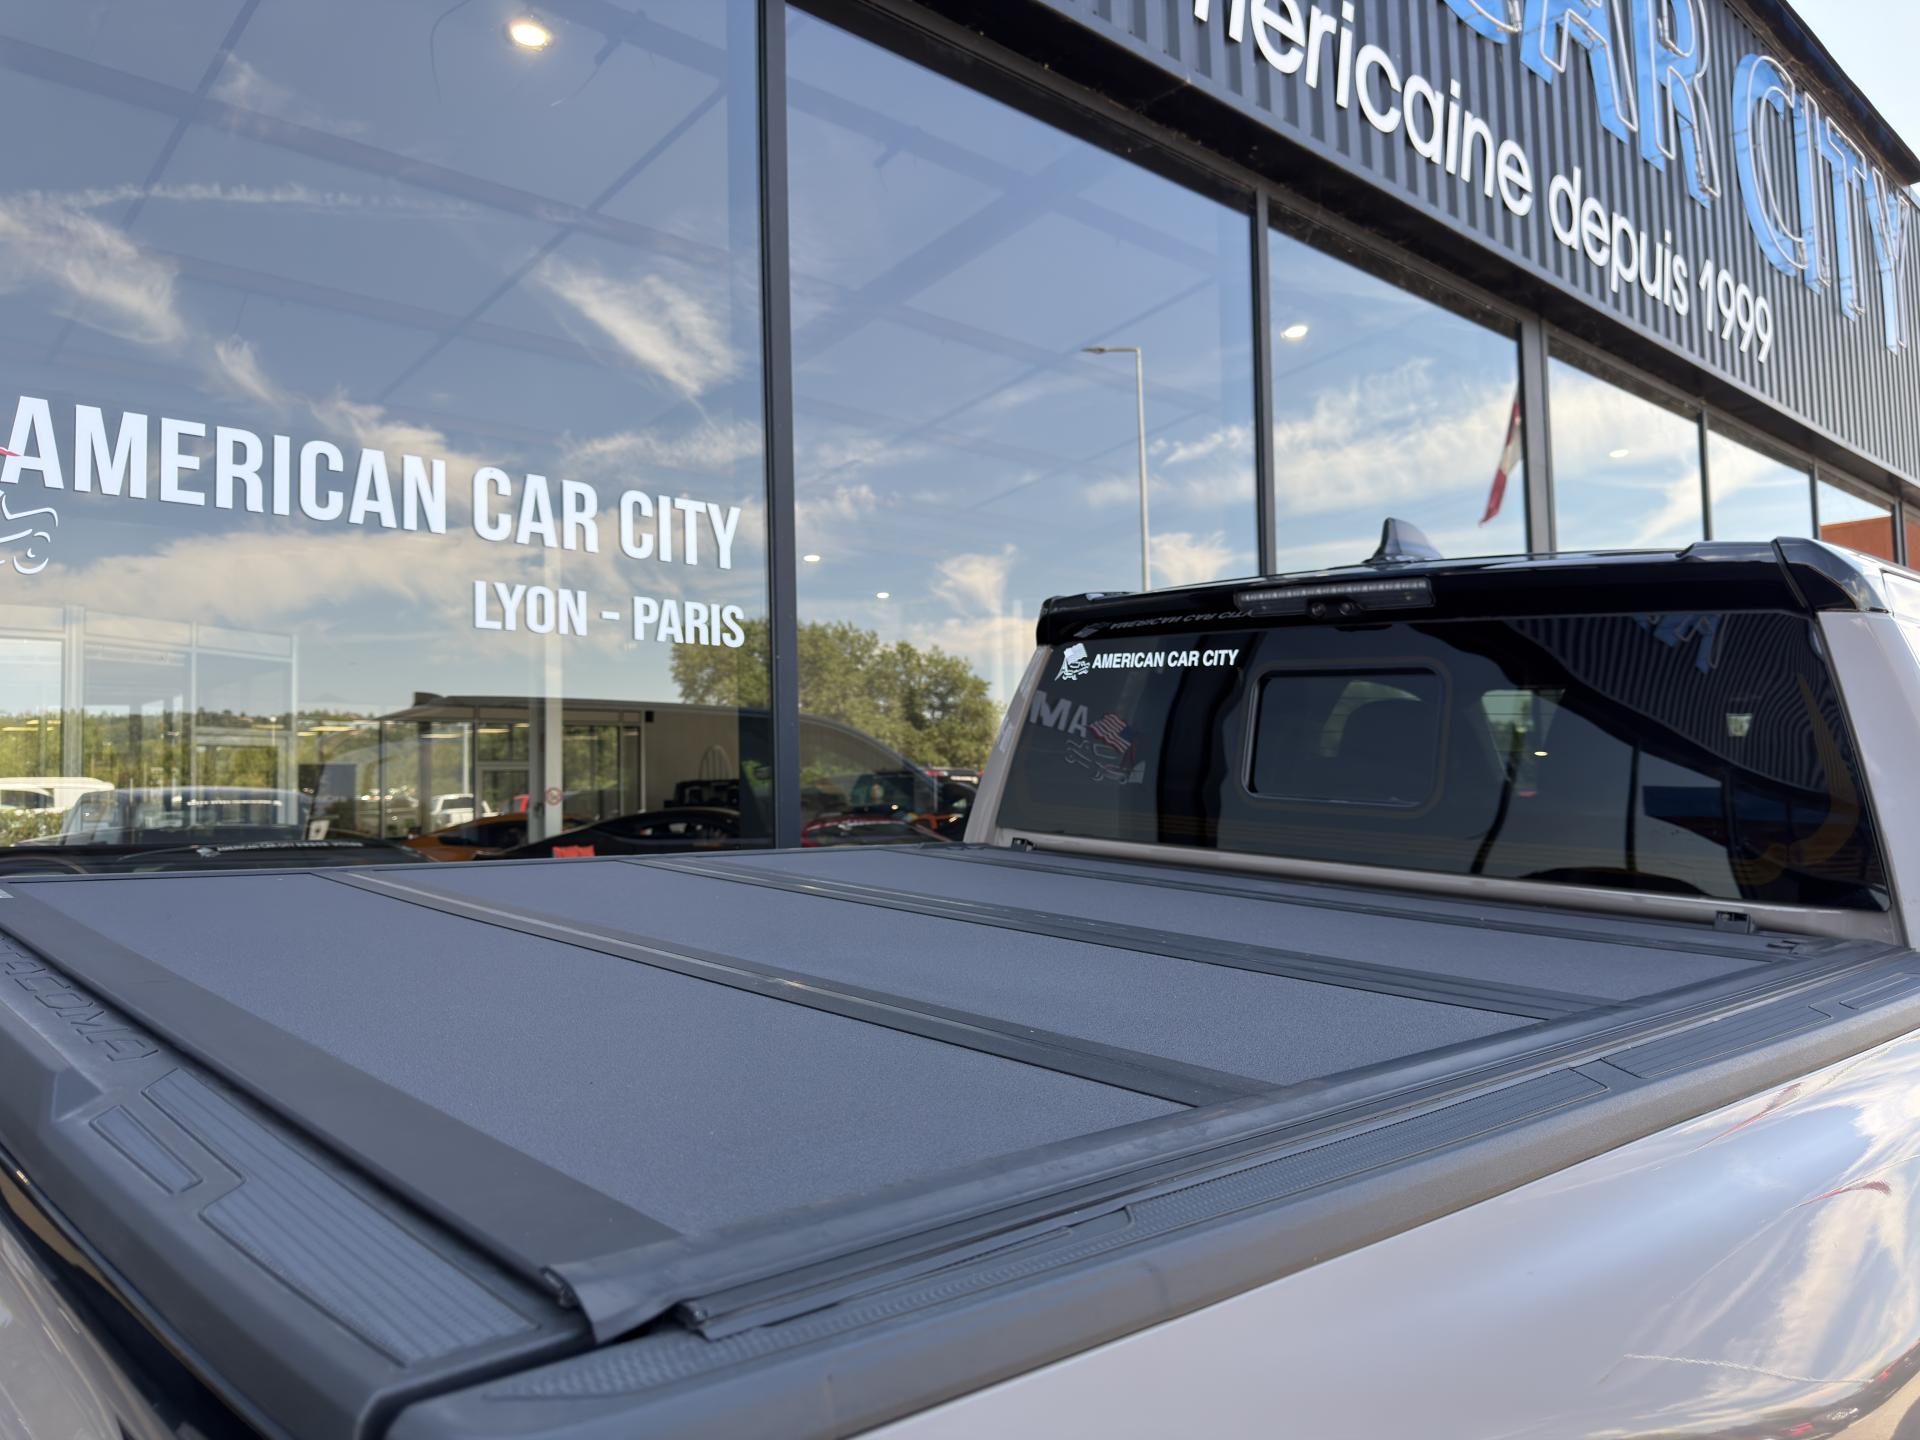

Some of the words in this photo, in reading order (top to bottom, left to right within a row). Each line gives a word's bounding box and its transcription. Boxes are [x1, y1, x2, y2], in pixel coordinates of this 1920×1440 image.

[1548, 166, 1689, 317] depuis
[1699, 260, 1774, 364] 1999
[1732, 53, 1910, 356] CITY
[0, 395, 446, 534] AMERICAN
[474, 466, 599, 553] CAR
[620, 490, 741, 570] CITY
[475, 580, 588, 636] LYON
[634, 596, 745, 648] PARIS
[1091, 651, 1166, 669] AMERICAN
[1167, 650, 1200, 668] CAR
[1202, 649, 1239, 667] CITY
